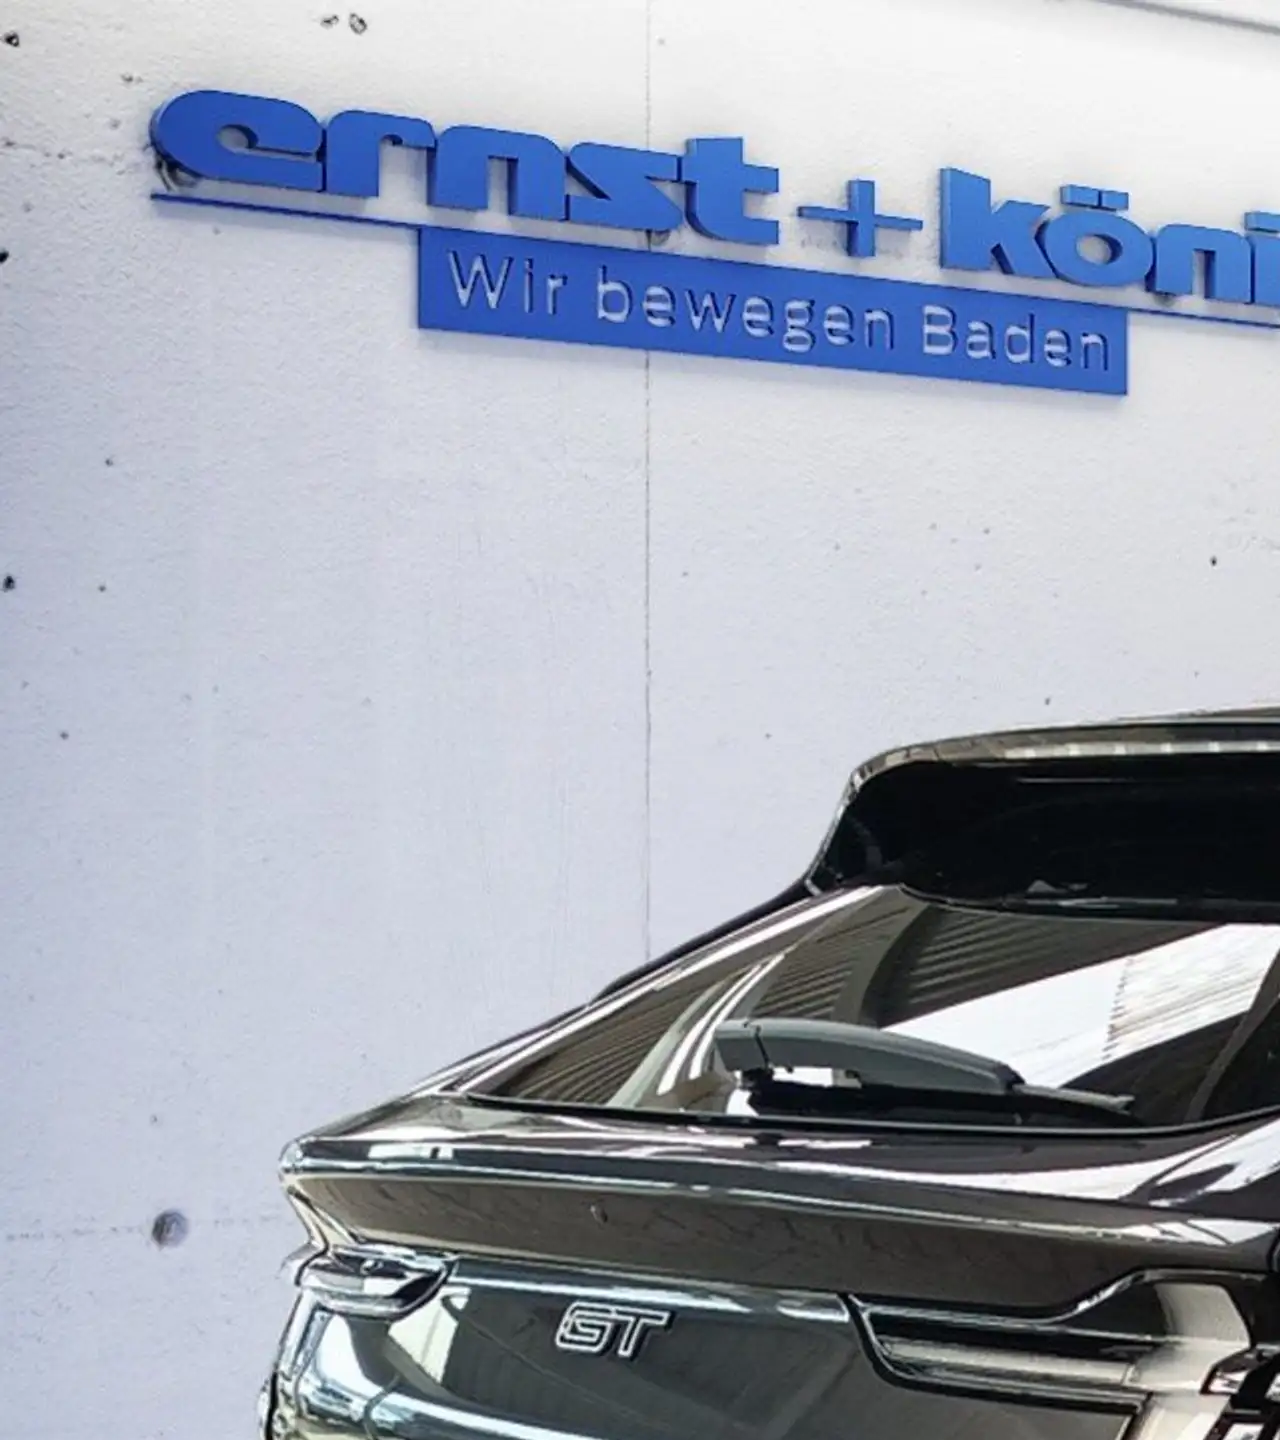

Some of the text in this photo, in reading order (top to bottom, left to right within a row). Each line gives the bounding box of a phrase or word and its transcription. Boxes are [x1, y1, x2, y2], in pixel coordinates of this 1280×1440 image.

[150, 91, 779, 245] ernst
[449, 250, 1109, 371] Wir bewegen Baden
[555, 1300, 673, 1358] GT
